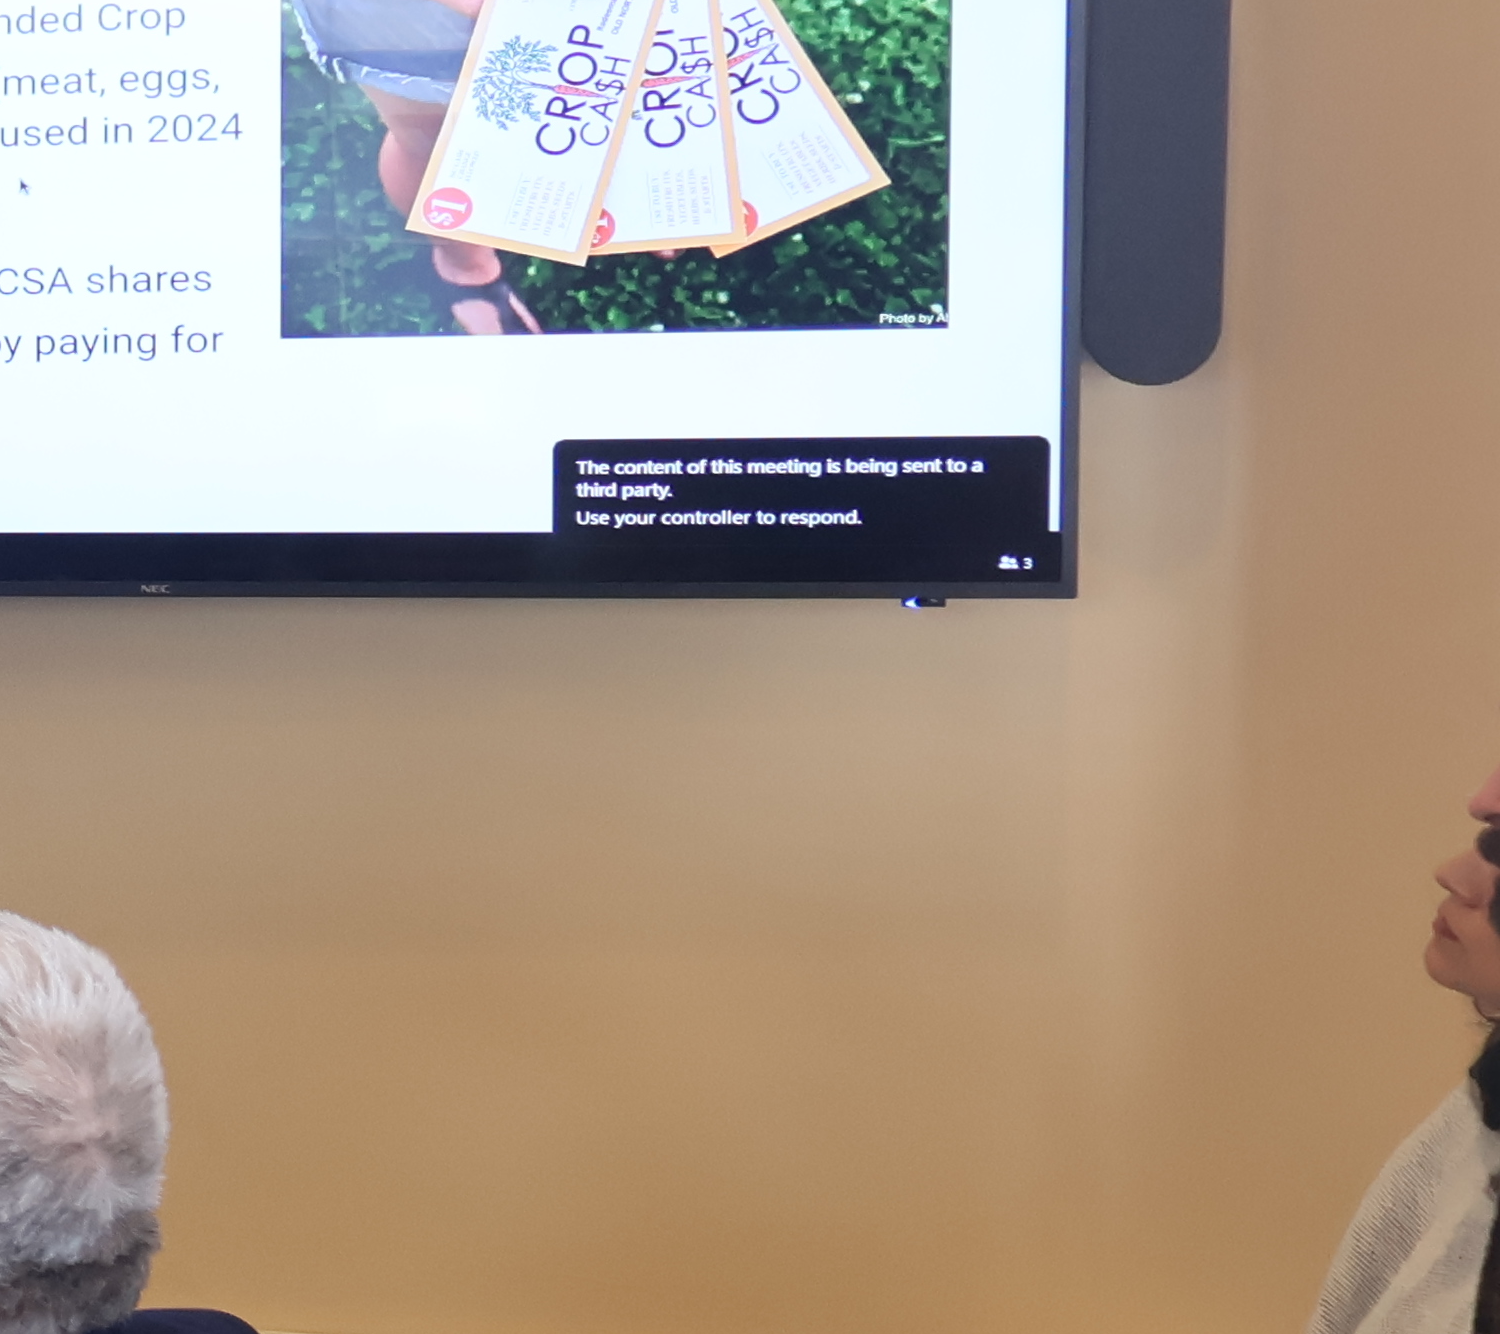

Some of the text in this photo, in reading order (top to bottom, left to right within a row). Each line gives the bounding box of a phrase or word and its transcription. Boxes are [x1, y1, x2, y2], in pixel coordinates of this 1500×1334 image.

[98, 4, 185, 36] Crop
[730, 7, 801, 93] CA$H
[120, 69, 218, 98] eggs,
[536, 24, 604, 155] CROP
[644, 28, 685, 148] CRO
[679, 36, 716, 127] CA$H
[580, 56, 631, 146] CA$H
[104, 123, 132, 144] in
[148, 113, 243, 142] 2024
[87, 265, 211, 293] shares
[879, 313, 934, 325] Photo by
[36, 328, 156, 362] paying
[171, 325, 223, 353] for
[576, 458, 983, 478] The content of this meeting is being sent to a
[576, 482, 672, 501] third party.
[576, 509, 863, 528] Use your controller to respond.
[1023, 556, 1033, 569] 3
[141, 584, 170, 594] NEC
